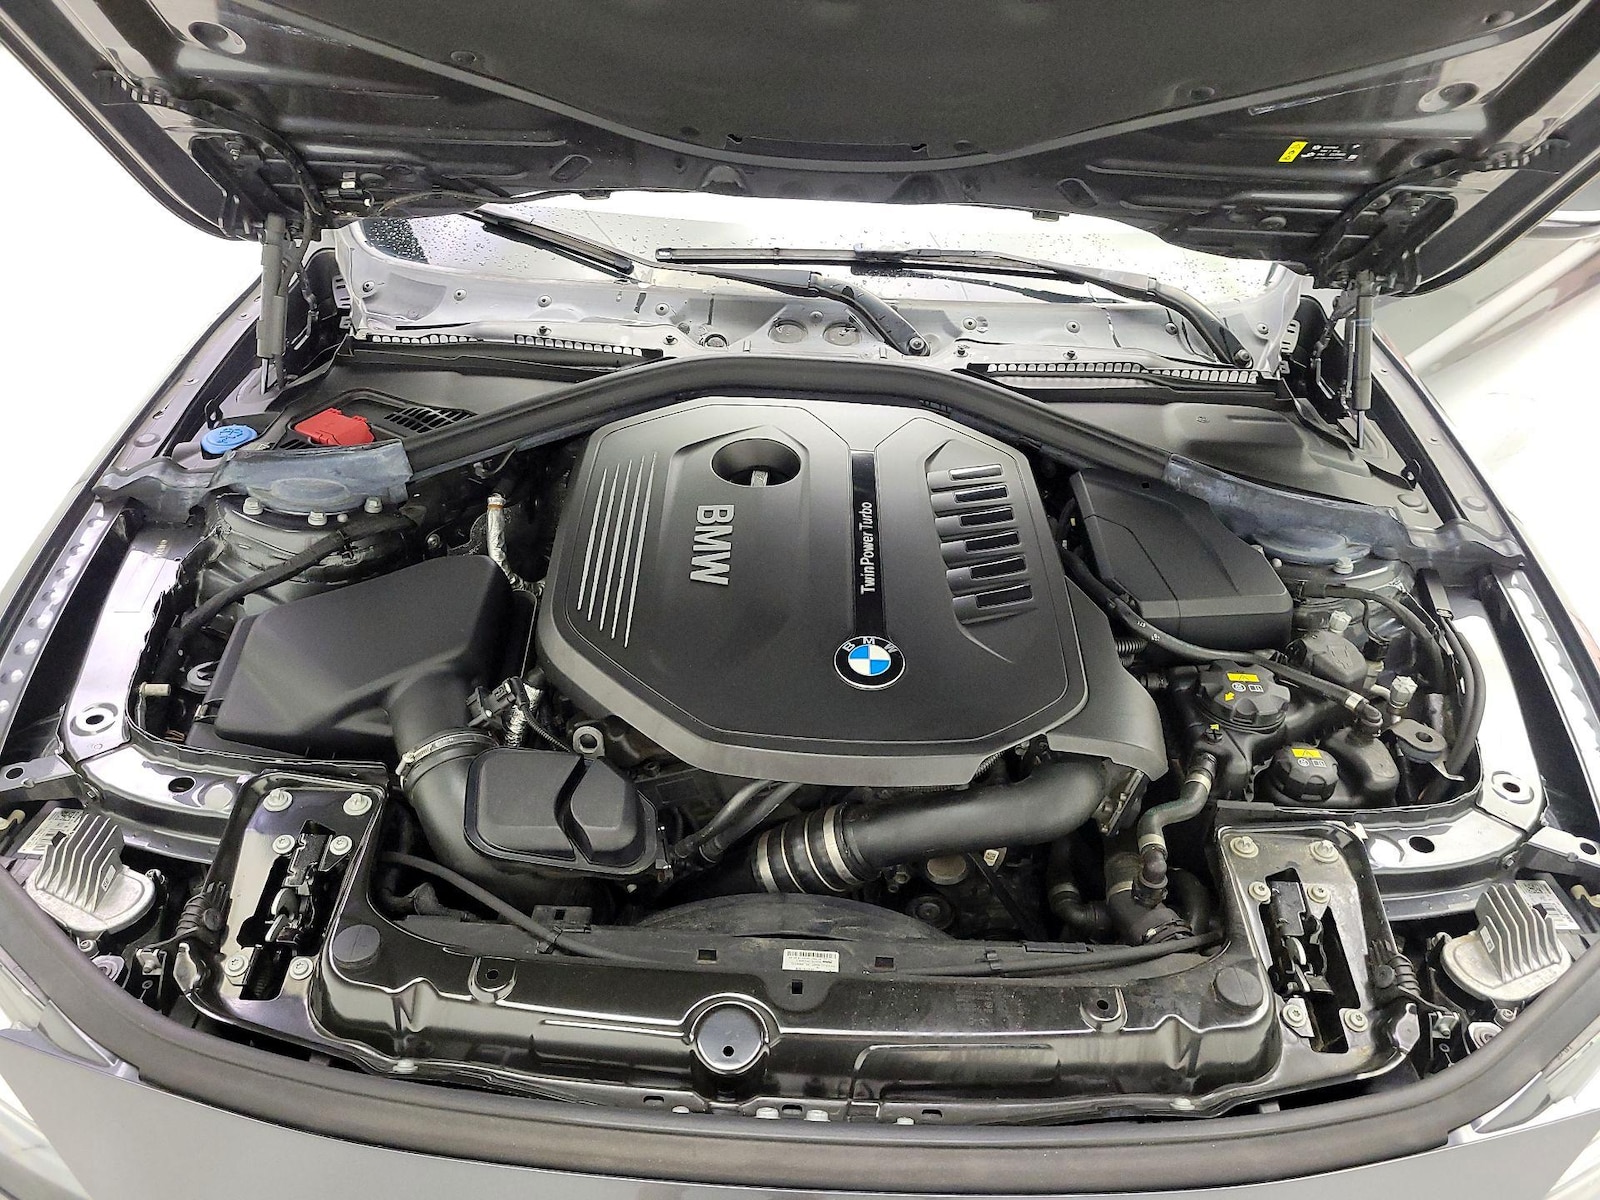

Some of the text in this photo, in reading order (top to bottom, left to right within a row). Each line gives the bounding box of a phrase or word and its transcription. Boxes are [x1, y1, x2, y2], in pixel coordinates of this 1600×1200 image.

[690, 504, 735, 586] BMW
[858, 501, 875, 595] TwinPower Turbo
[842, 637, 898, 653] BMW
